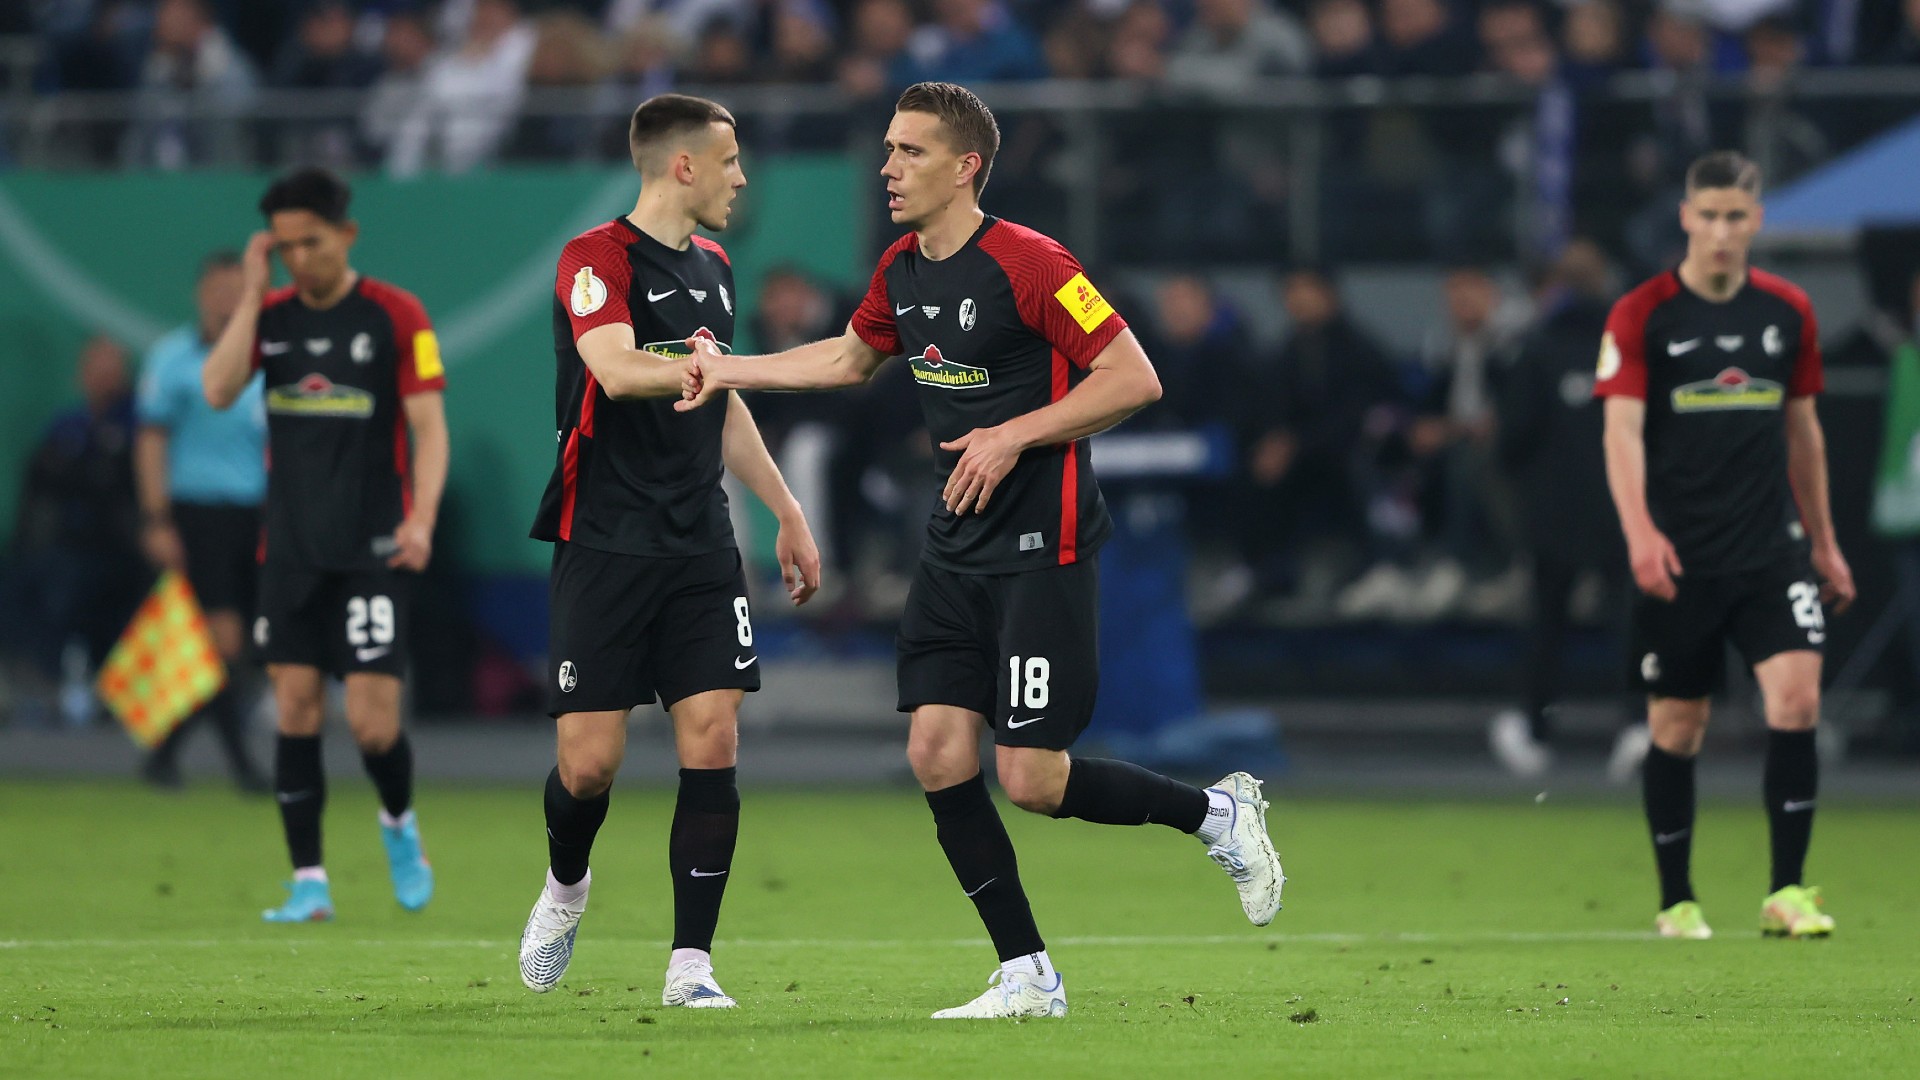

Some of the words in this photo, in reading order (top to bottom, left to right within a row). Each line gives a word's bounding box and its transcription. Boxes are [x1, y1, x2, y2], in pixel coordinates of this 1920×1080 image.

[1081, 295, 1101, 314] LOTTO
[345, 594, 395, 645] 29
[733, 596, 753, 647] 8
[1009, 655, 1050, 709] 18
